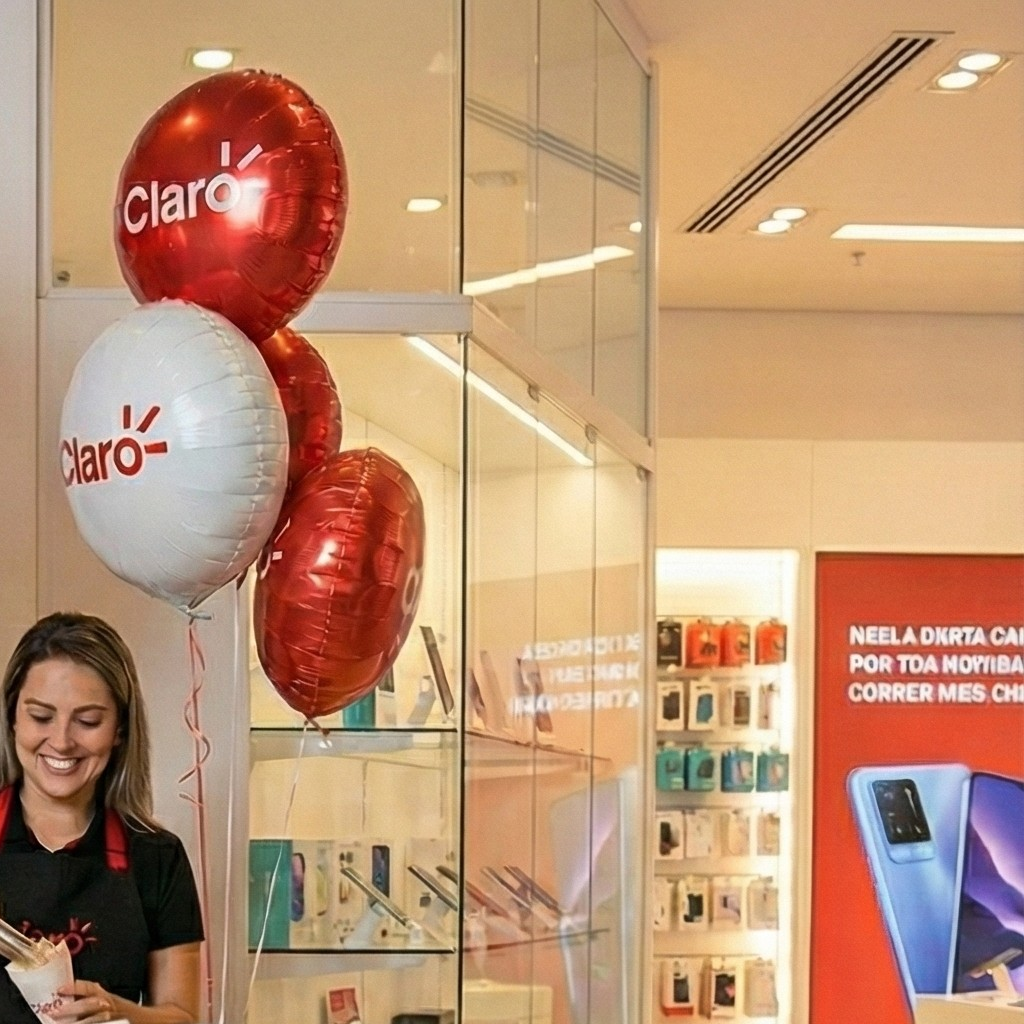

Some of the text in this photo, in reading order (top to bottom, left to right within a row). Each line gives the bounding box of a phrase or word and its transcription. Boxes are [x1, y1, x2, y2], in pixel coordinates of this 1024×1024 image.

[124, 172, 241, 234] Claro
[60, 436, 143, 487] Claro
[849, 653, 893, 674] POR
[848, 681, 935, 703] CORRER
[937, 682, 987, 703] MES
